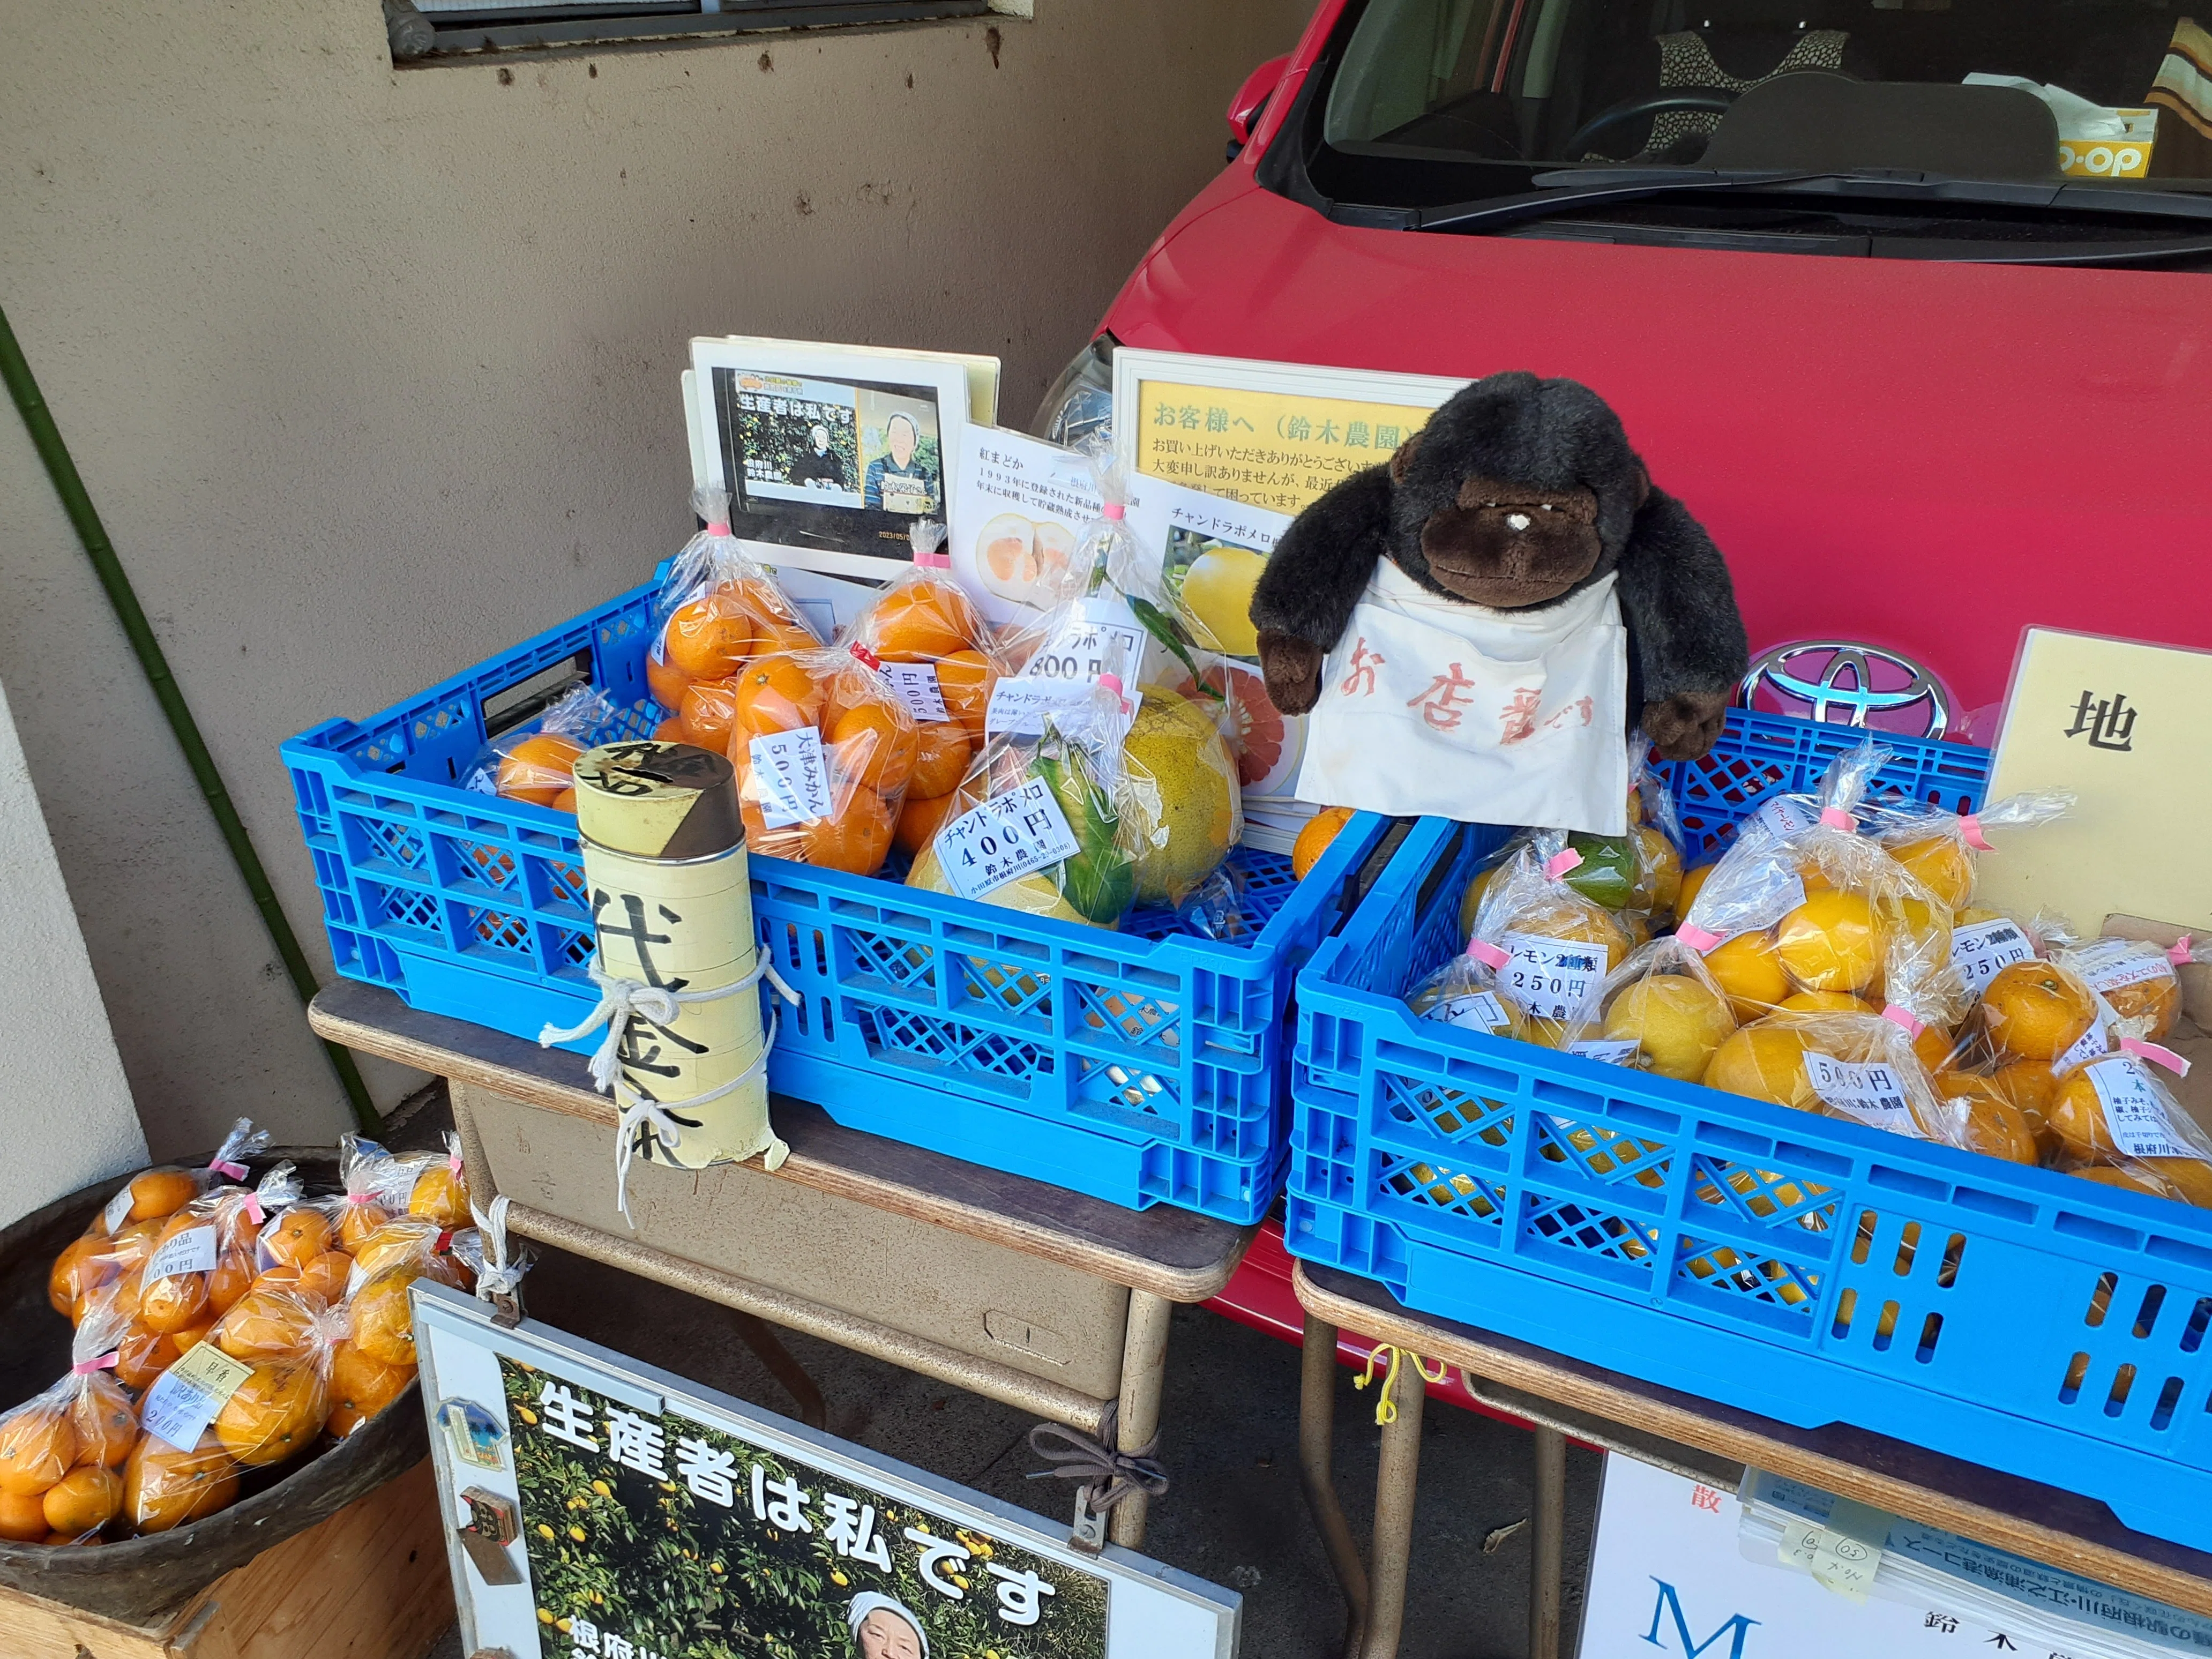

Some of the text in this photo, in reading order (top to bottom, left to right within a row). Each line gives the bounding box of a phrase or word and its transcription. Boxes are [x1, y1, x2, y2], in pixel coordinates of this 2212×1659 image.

[740, 393, 852, 424] 生産者は私です
[979, 447, 1023, 469] 紅まどか
[879, 531, 910, 541] 2023/05/0
[902, 672, 928, 714] 500円
[2063, 690, 2138, 752] 地
[772, 744, 798, 812] 500円
[795, 731, 824, 813] 大津みかん
[944, 784, 1044, 849] チャンドラポメロ
[1770, 801, 1795, 831] マイヤーレモン
[962, 809, 1052, 868] 400円
[984, 839, 1047, 876] 鈴木農園
[1510, 945, 1598, 973] レモン2種類
[1963, 947, 2025, 980] 250円
[1513, 972, 1586, 998] 250円
[1818, 1062, 1893, 1092] 500円
[153, 1259, 193, 1279] 00円
[205, 1361, 230, 1384] 早香
[146, 1409, 183, 1438] 200円
[538, 1381, 1057, 1627] 生産者は私です
[1827, 1561, 1862, 1581] No.4
